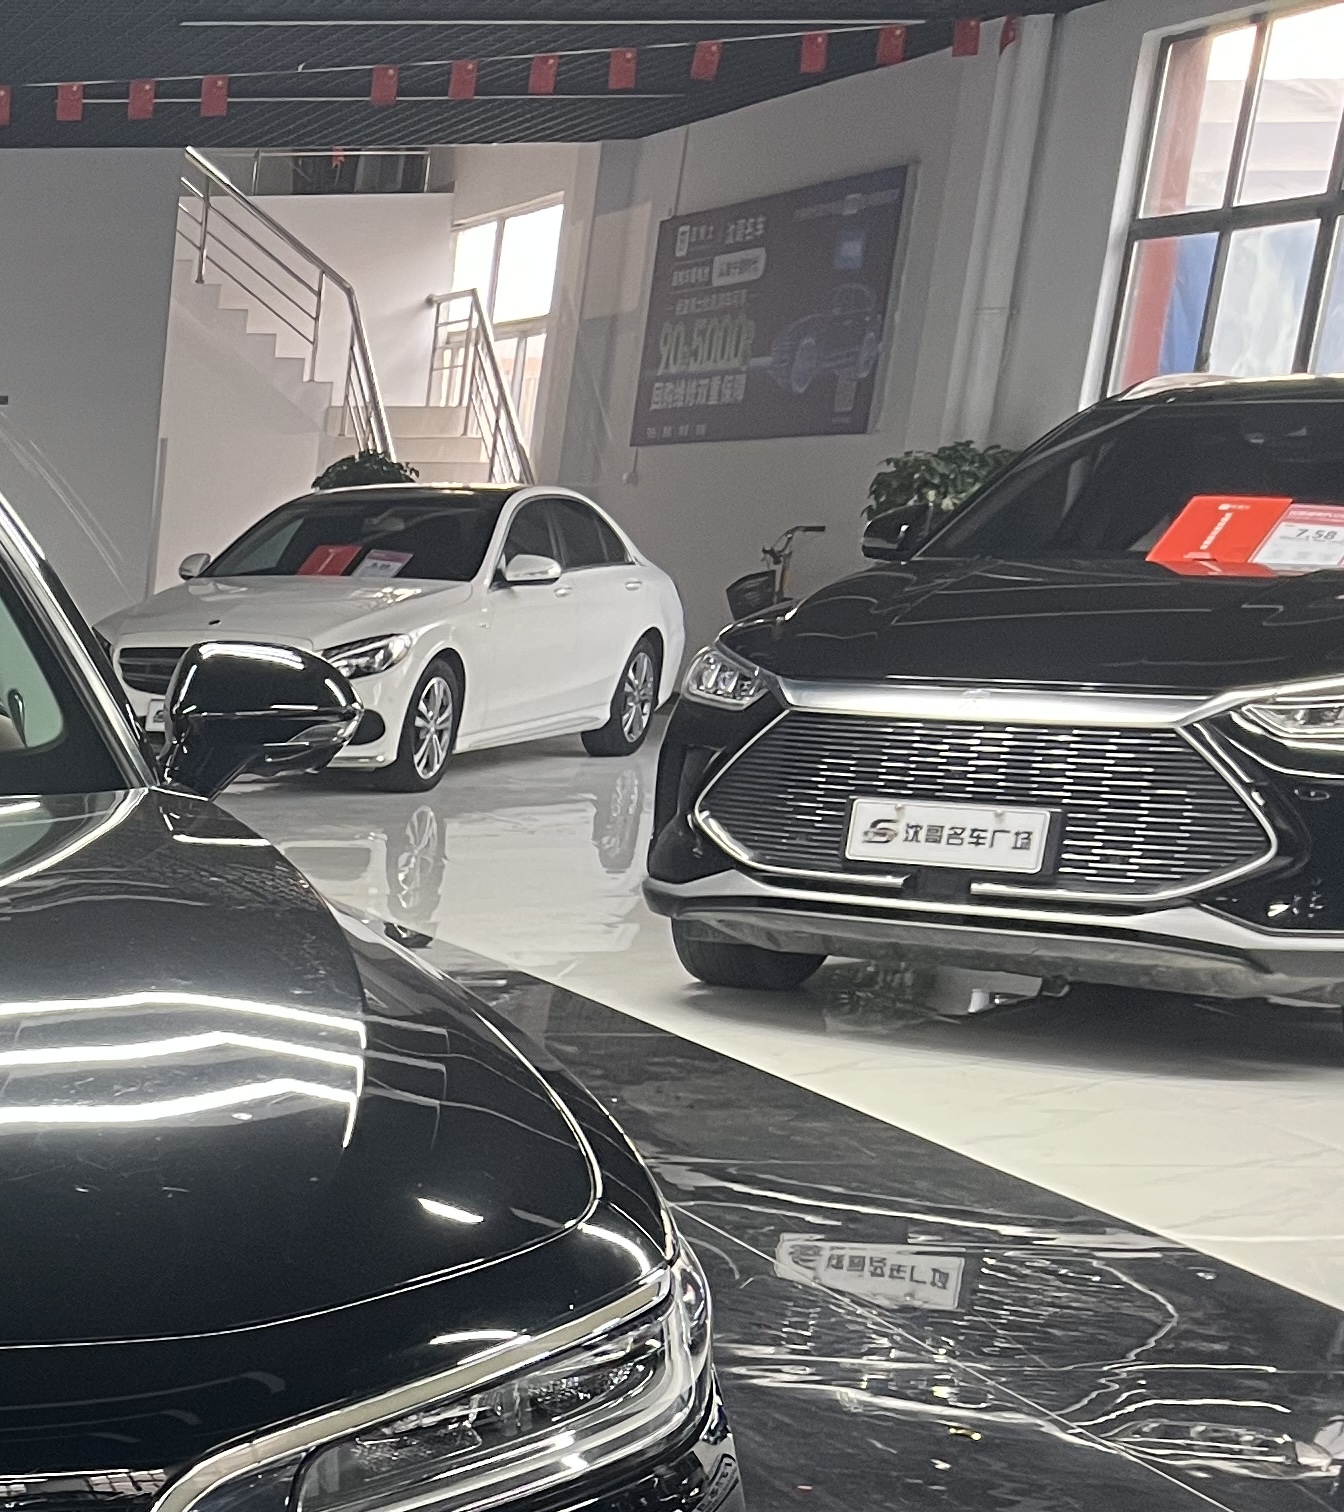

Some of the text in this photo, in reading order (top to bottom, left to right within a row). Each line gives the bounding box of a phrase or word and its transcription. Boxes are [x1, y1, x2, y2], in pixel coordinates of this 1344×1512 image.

[903, 822, 1033, 851] 沈哥名车广场
